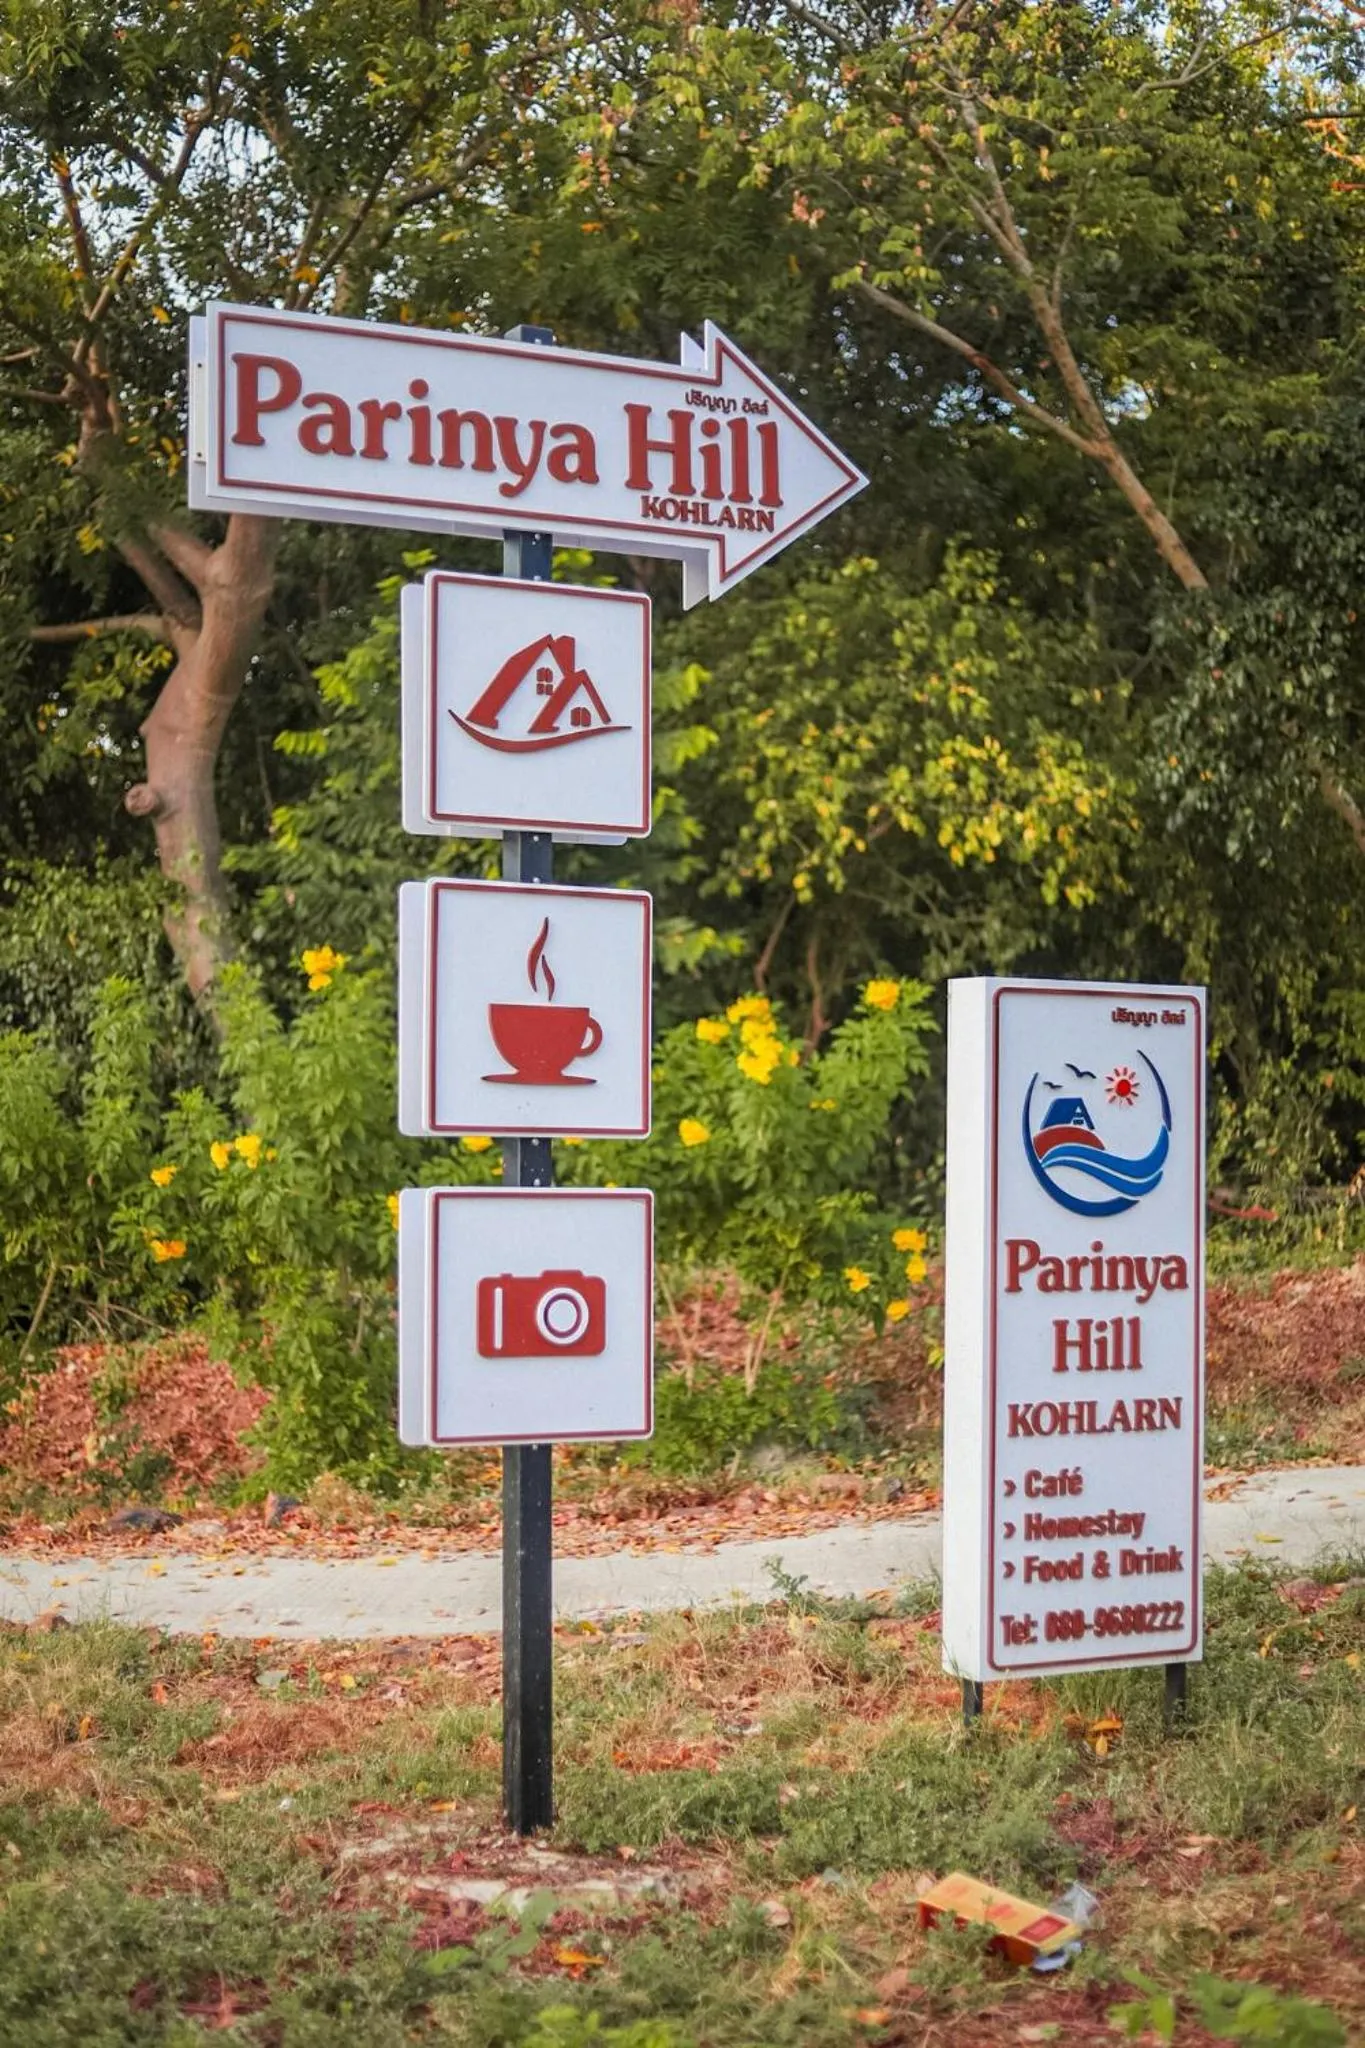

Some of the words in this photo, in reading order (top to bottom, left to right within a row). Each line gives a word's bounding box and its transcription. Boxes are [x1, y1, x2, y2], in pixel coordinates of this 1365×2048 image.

[231, 352, 599, 497] Parinya
[624, 403, 783, 507] Hill
[640, 495, 775, 533] KOHLARN
[1004, 1239, 1189, 1304] Parinya
[1052, 1316, 1143, 1373] Hill
[1007, 1397, 1183, 1438] KOHLARN
[1024, 1466, 1084, 1498] Café
[1024, 1508, 1146, 1541] Homestay
[1023, 1552, 1085, 1584] Food
[1091, 1550, 1111, 1579] &
[1119, 1545, 1184, 1576] Drink
[1000, 1613, 1038, 1647] Tel:
